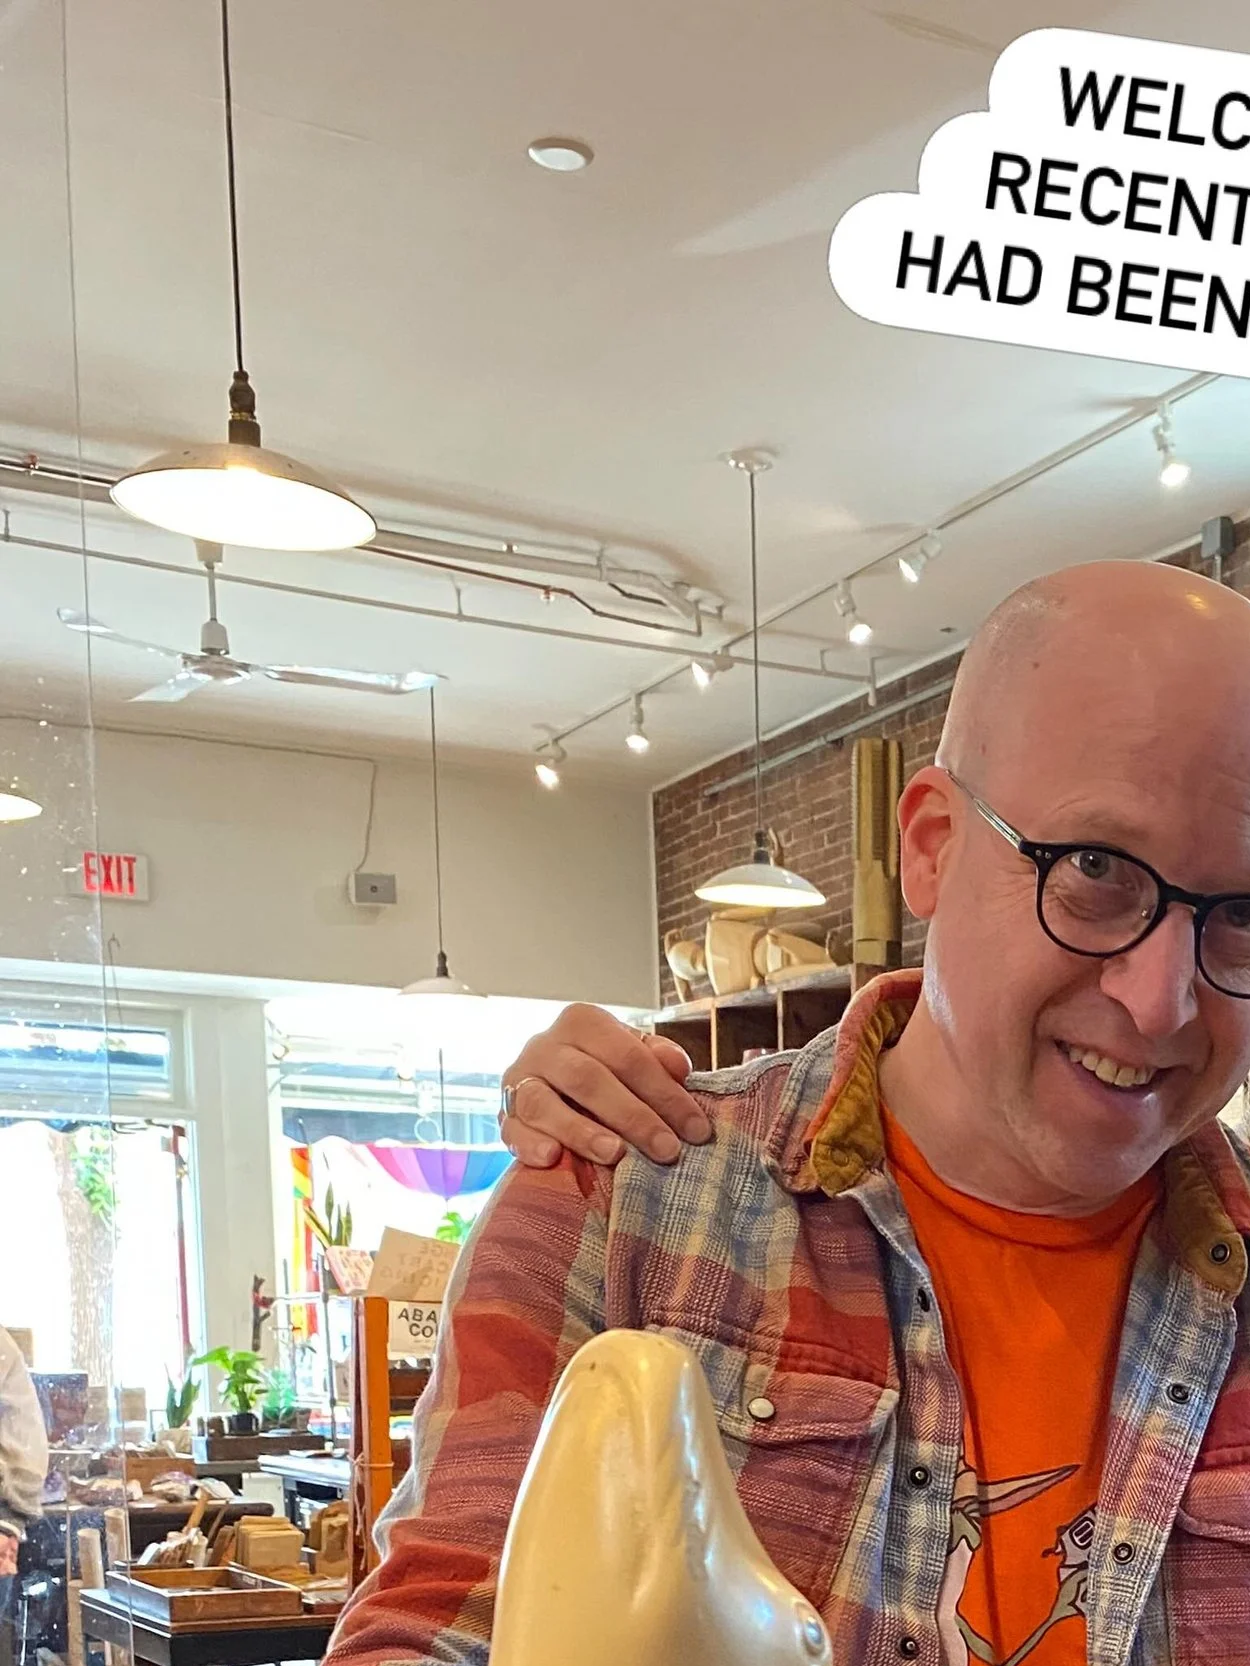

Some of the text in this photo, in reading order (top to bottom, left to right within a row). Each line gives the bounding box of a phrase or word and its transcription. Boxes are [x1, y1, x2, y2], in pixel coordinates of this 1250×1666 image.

[84, 852, 136, 896] EXIT
[397, 1308, 438, 1324] ABA
[409, 1323, 439, 1338] CO
